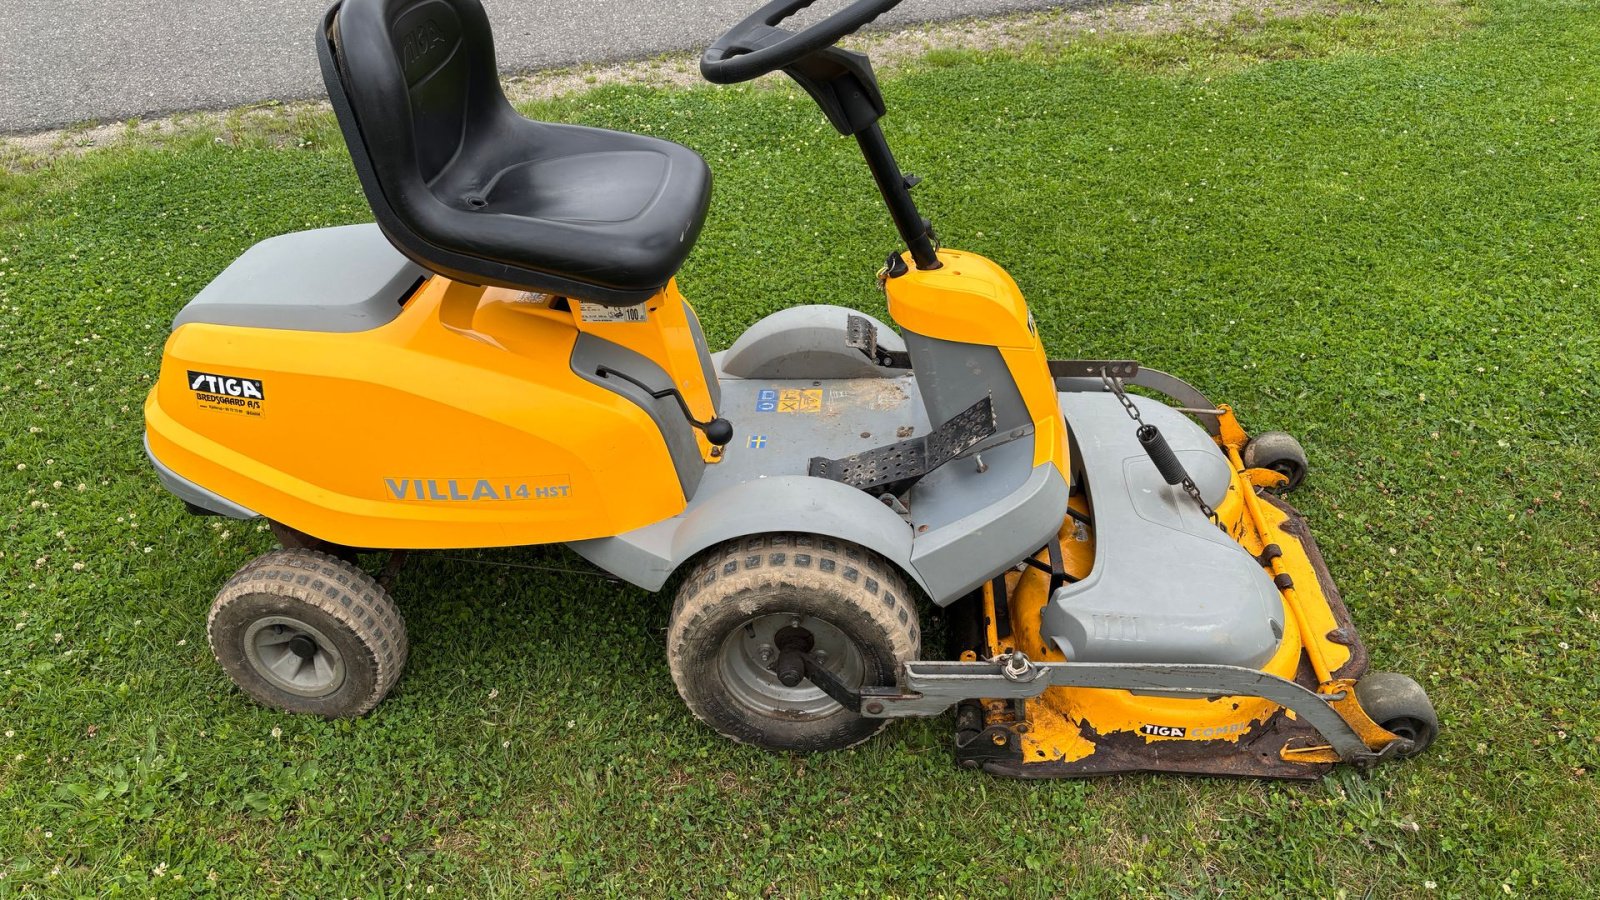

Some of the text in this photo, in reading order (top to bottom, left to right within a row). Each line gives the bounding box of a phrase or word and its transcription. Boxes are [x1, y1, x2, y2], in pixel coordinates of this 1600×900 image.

[626, 308, 639, 321] 100
[192, 374, 262, 399] STIGA
[196, 393, 245, 407] BREDSGAARD
[247, 400, 261, 410] A/S
[384, 478, 570, 501] VILLA 14 HST
[1191, 722, 1244, 737] COMBI
